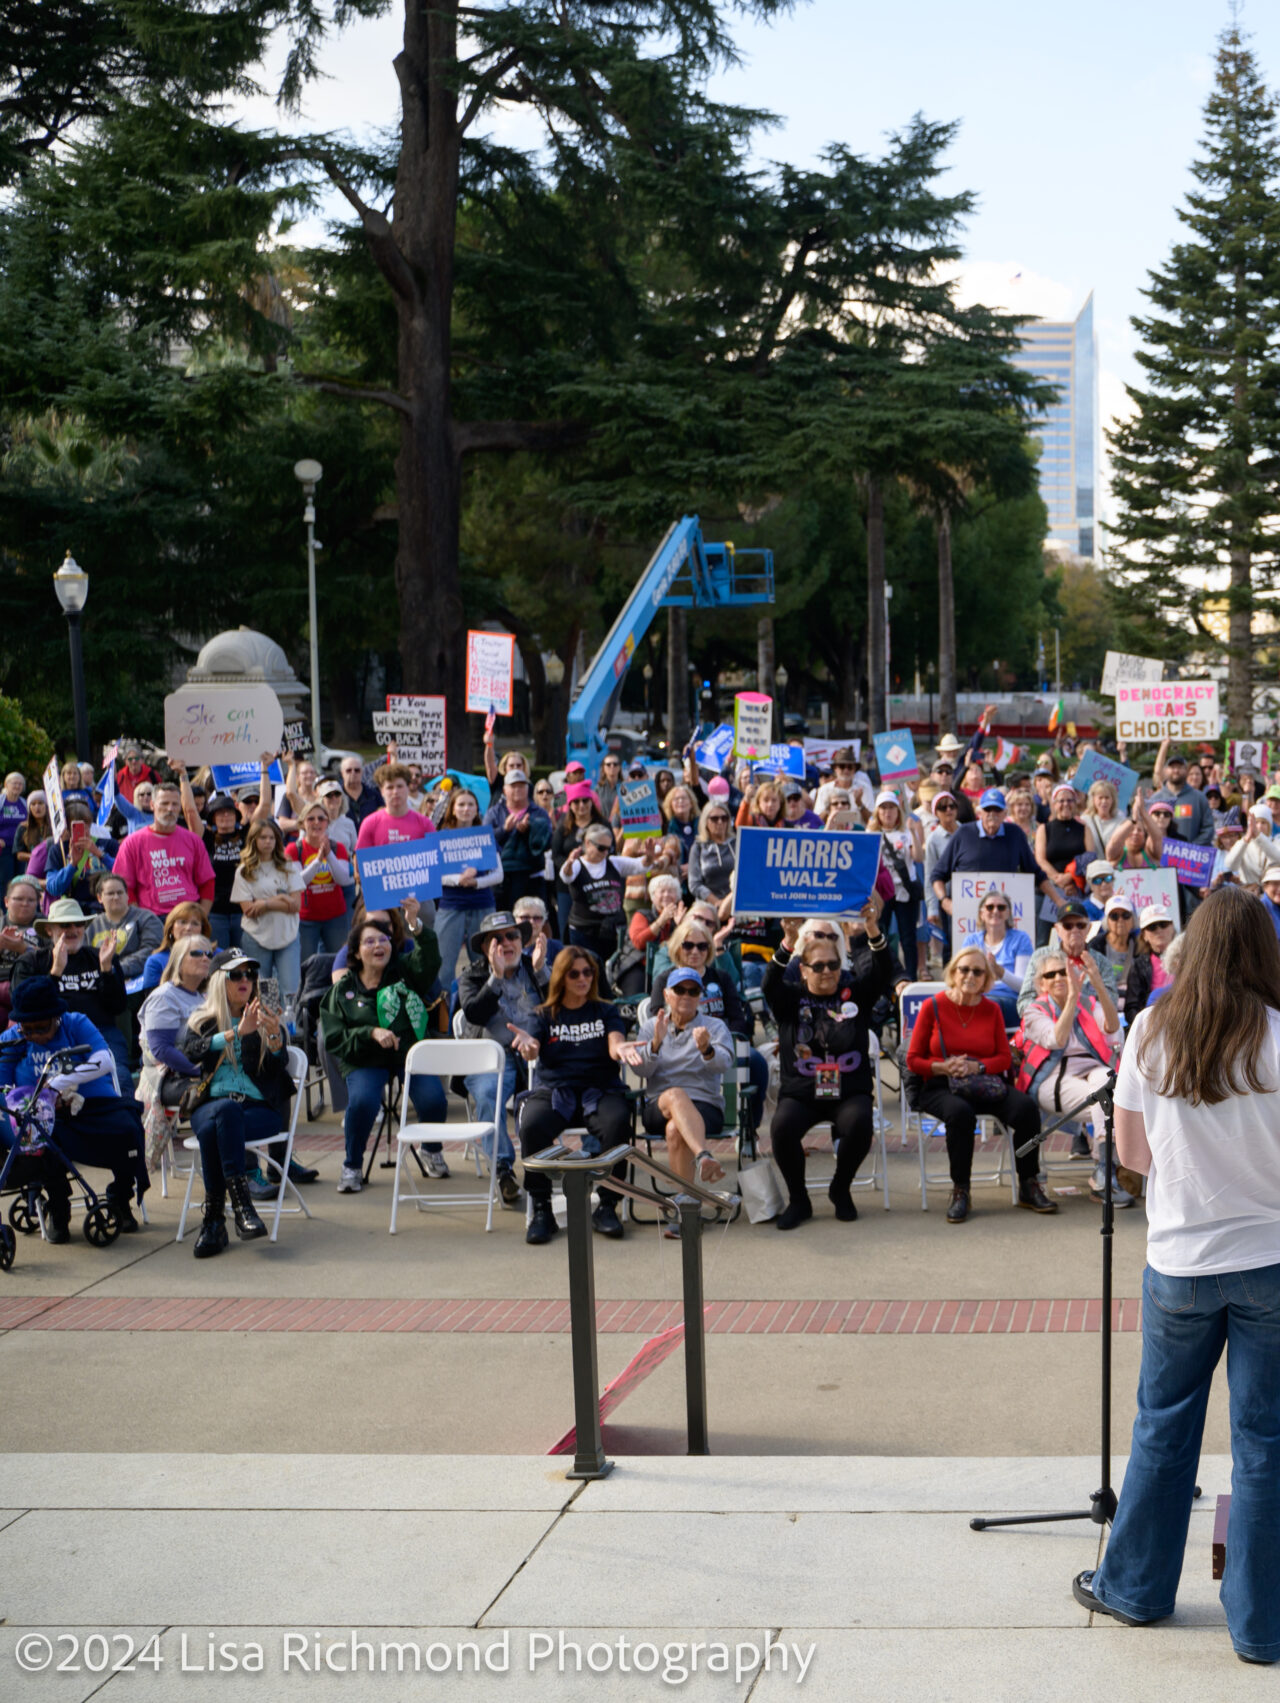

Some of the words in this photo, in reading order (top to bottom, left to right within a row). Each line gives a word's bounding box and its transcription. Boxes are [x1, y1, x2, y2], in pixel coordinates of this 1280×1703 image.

[1119, 686, 1215, 702] DEMOCRACY
[185, 703, 216, 725] She
[227, 706, 254, 722] can
[1144, 702, 1197, 717] MEANS
[375, 717, 389, 727] WE
[179, 729, 200, 746] do
[376, 732, 391, 746] GO
[439, 834, 492, 853] PRODUCTIVE
[443, 847, 483, 864] FREEDOM
[766, 837, 854, 870] HARRIS
[1163, 843, 1210, 864] HARRIS
[151, 857, 186, 869] WON'T
[363, 849, 439, 878] REPRODUCTIVE
[1167, 855, 1203, 873] WALZ
[153, 868, 169, 878] GO
[155, 874, 182, 888] BACK
[382, 868, 430, 891] FREEDOM
[779, 870, 838, 888] WALZ
[770, 892, 787, 900] Text
[788, 892, 807, 901] JOIN
[81, 970, 99, 980] THE
[549, 1019, 605, 1036] HARRIS
[560, 1030, 605, 1042] PRESIDENT
